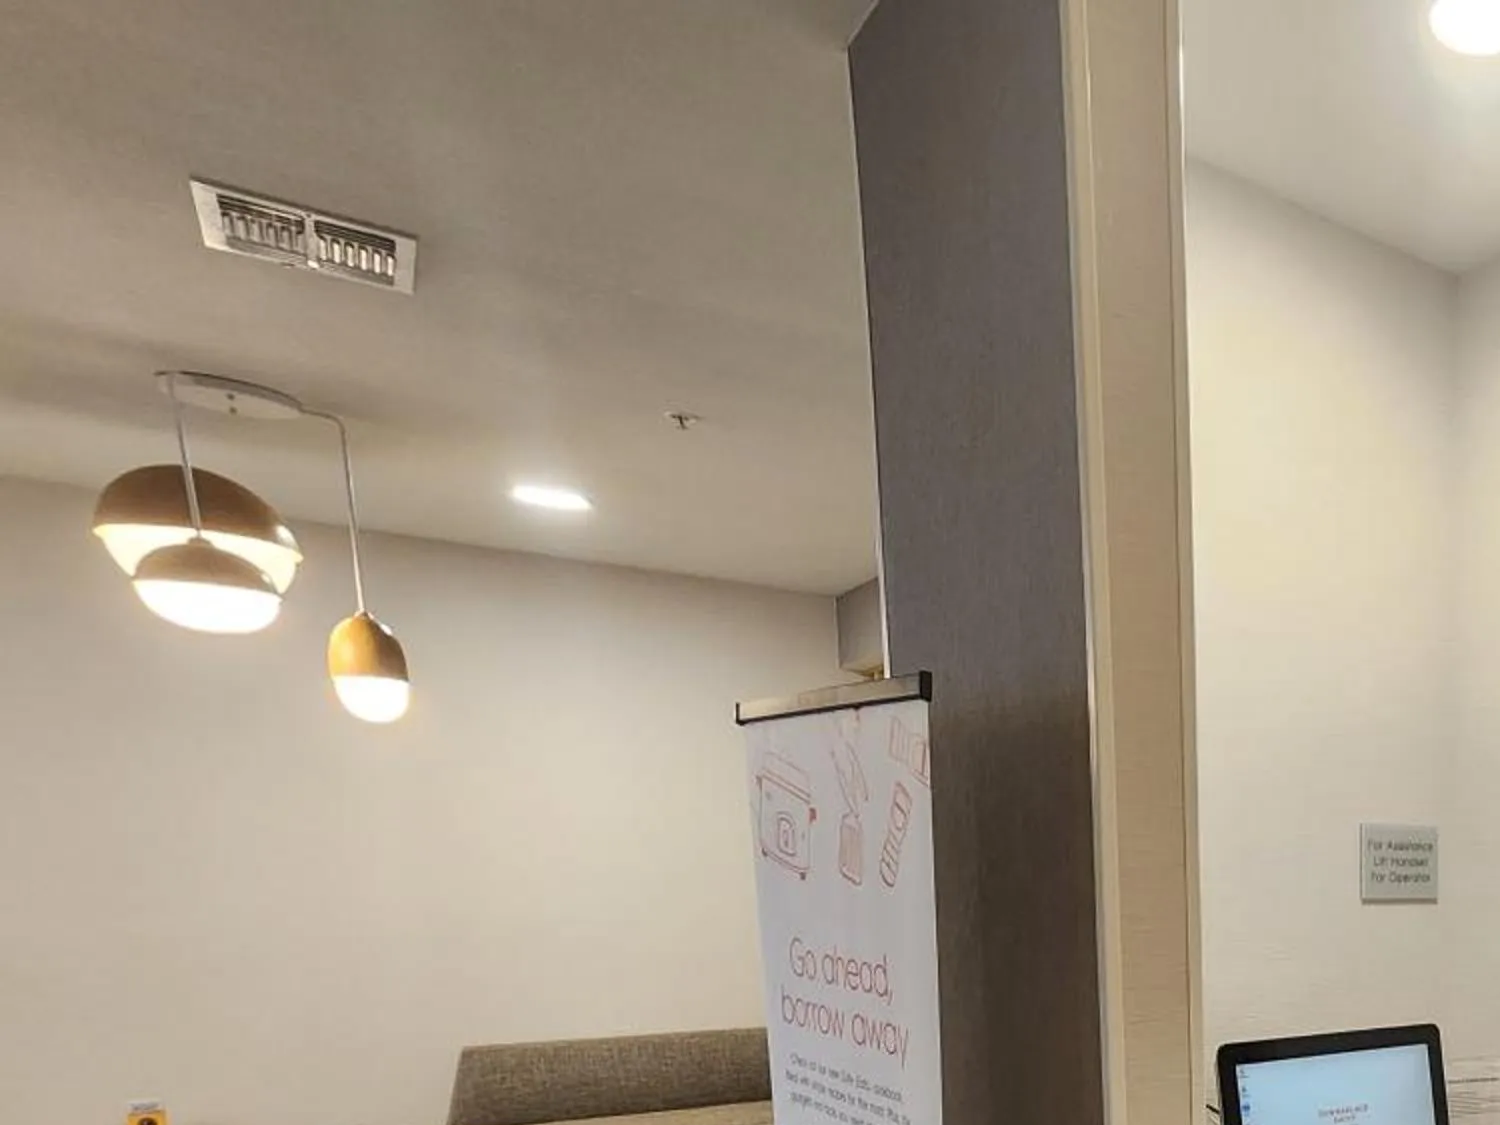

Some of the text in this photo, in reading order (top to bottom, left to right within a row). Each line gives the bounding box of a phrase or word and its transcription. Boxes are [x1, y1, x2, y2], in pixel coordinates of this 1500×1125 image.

[1367, 839, 1433, 852] For Assistance
[1388, 871, 1431, 886] Operator
[789, 937, 894, 1007] Go ahead,
[780, 983, 910, 1070] borrow away
